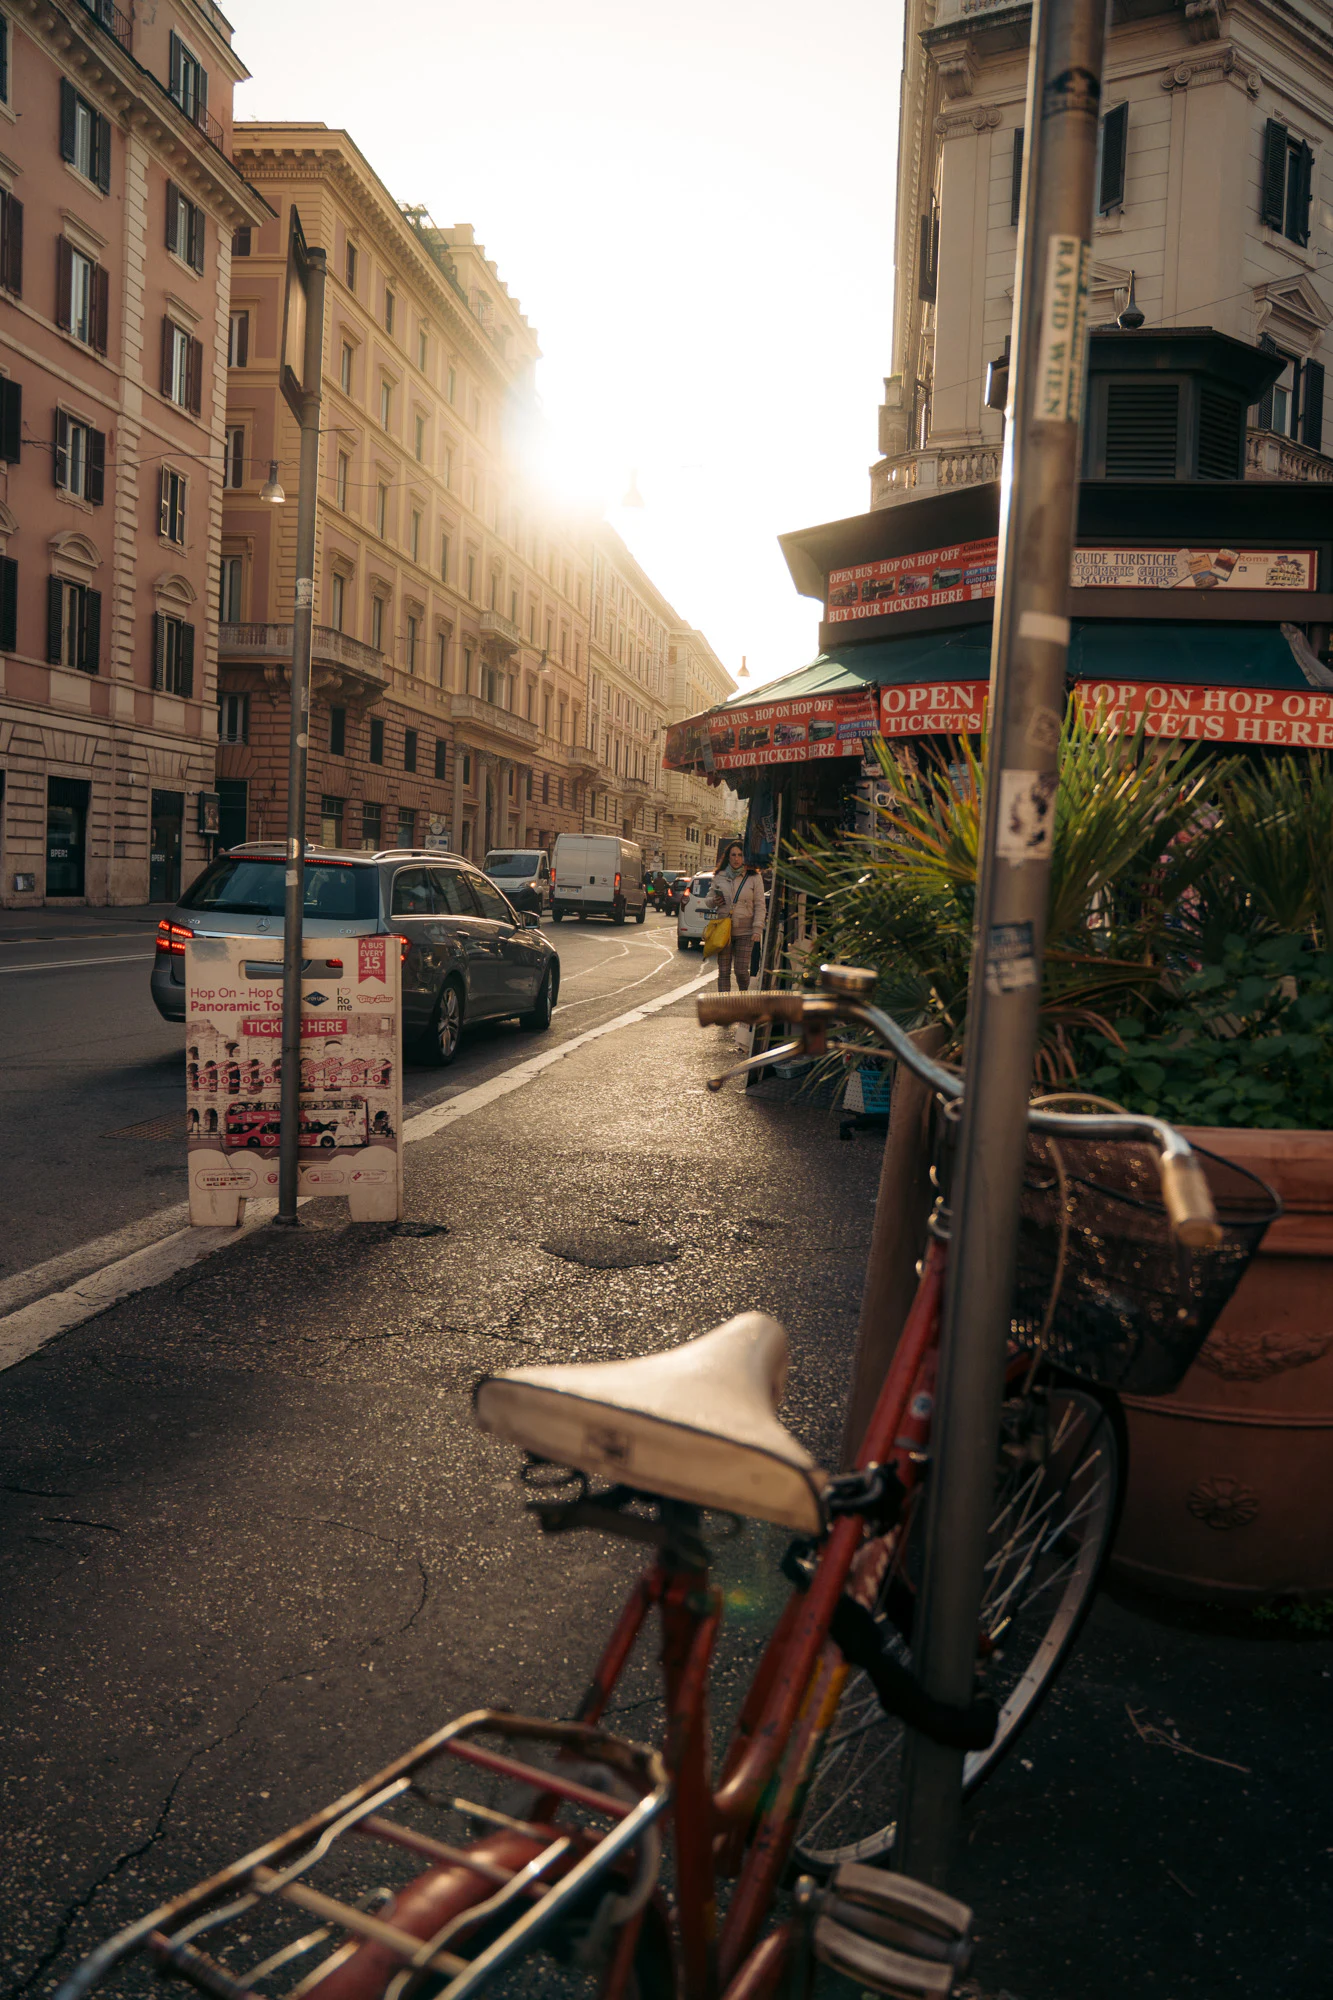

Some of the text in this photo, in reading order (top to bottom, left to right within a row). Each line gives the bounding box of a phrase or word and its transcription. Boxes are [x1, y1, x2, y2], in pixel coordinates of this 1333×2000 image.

[1043, 240, 1075, 415] RAPID WIEN
[1074, 552, 1177, 566] GUIDE TURISTICHE
[1239, 555, 1269, 563] Roma
[829, 570, 854, 584] OPEN
[855, 566, 873, 579] BUS
[879, 560, 900, 574] HOP
[901, 557, 916, 570] ON
[917, 552, 939, 567] HOP
[940, 548, 960, 561] OFF
[1076, 565, 1178, 578] TOURISTIC GUIDES
[965, 576, 987, 585] GUIDED
[1080, 576, 1120, 585] MAPPE
[1137, 576, 1170, 585] MAPS
[829, 588, 964, 622] BUY YOUR TICKETS HERE
[882, 685, 976, 713] OPEN
[1145, 687, 1194, 710] ON
[1203, 690, 1274, 715] HOP
[731, 711, 749, 725] BUS
[755, 708, 774, 721] HOP
[775, 705, 790, 718] ON
[791, 702, 813, 716] HOP
[814, 699, 834, 712] OFF
[839, 723, 851, 731] SKIP
[861, 720, 876, 728] LINE
[886, 713, 981, 735] TICKETS
[838, 730, 857, 739] GUIDED
[1234, 717, 1333, 746] HERE
[728, 752, 757, 768] YOUR
[758, 747, 807, 763] TICKETS
[808, 742, 836, 758] HERE
[364, 957, 381, 970] 15
[191, 987, 216, 1000] Hop
[218, 988, 237, 998] On
[248, 987, 274, 1000] Hop
[337, 996, 350, 1004] Ro
[190, 1001, 283, 1012] Panoramic To
[246, 1021, 343, 1033] TICKS HERE
